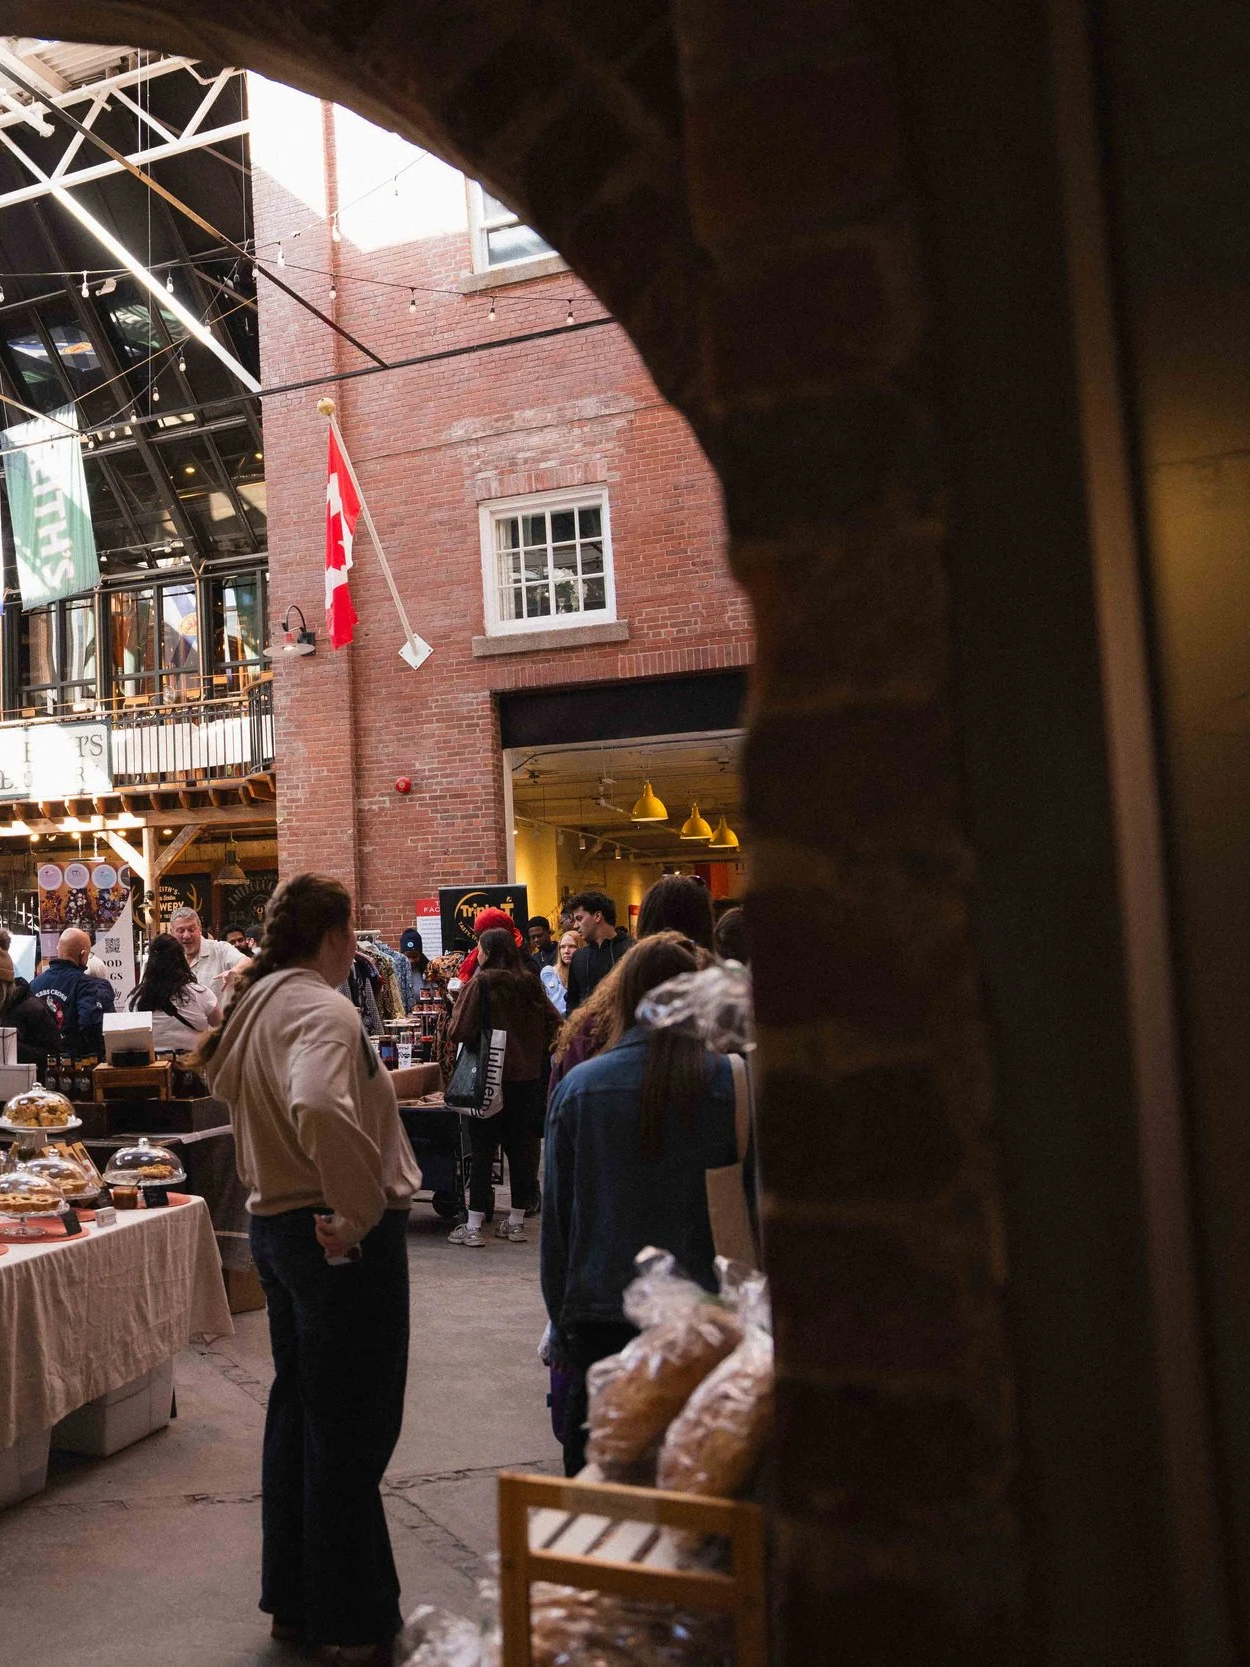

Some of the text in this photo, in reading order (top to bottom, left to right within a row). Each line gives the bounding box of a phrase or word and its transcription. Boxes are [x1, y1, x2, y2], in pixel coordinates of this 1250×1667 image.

[159, 886, 179, 896] EITH'S
[159, 901, 184, 912] WERY
[110, 973, 123, 981] GS
[50, 989, 68, 1002] CROSS
